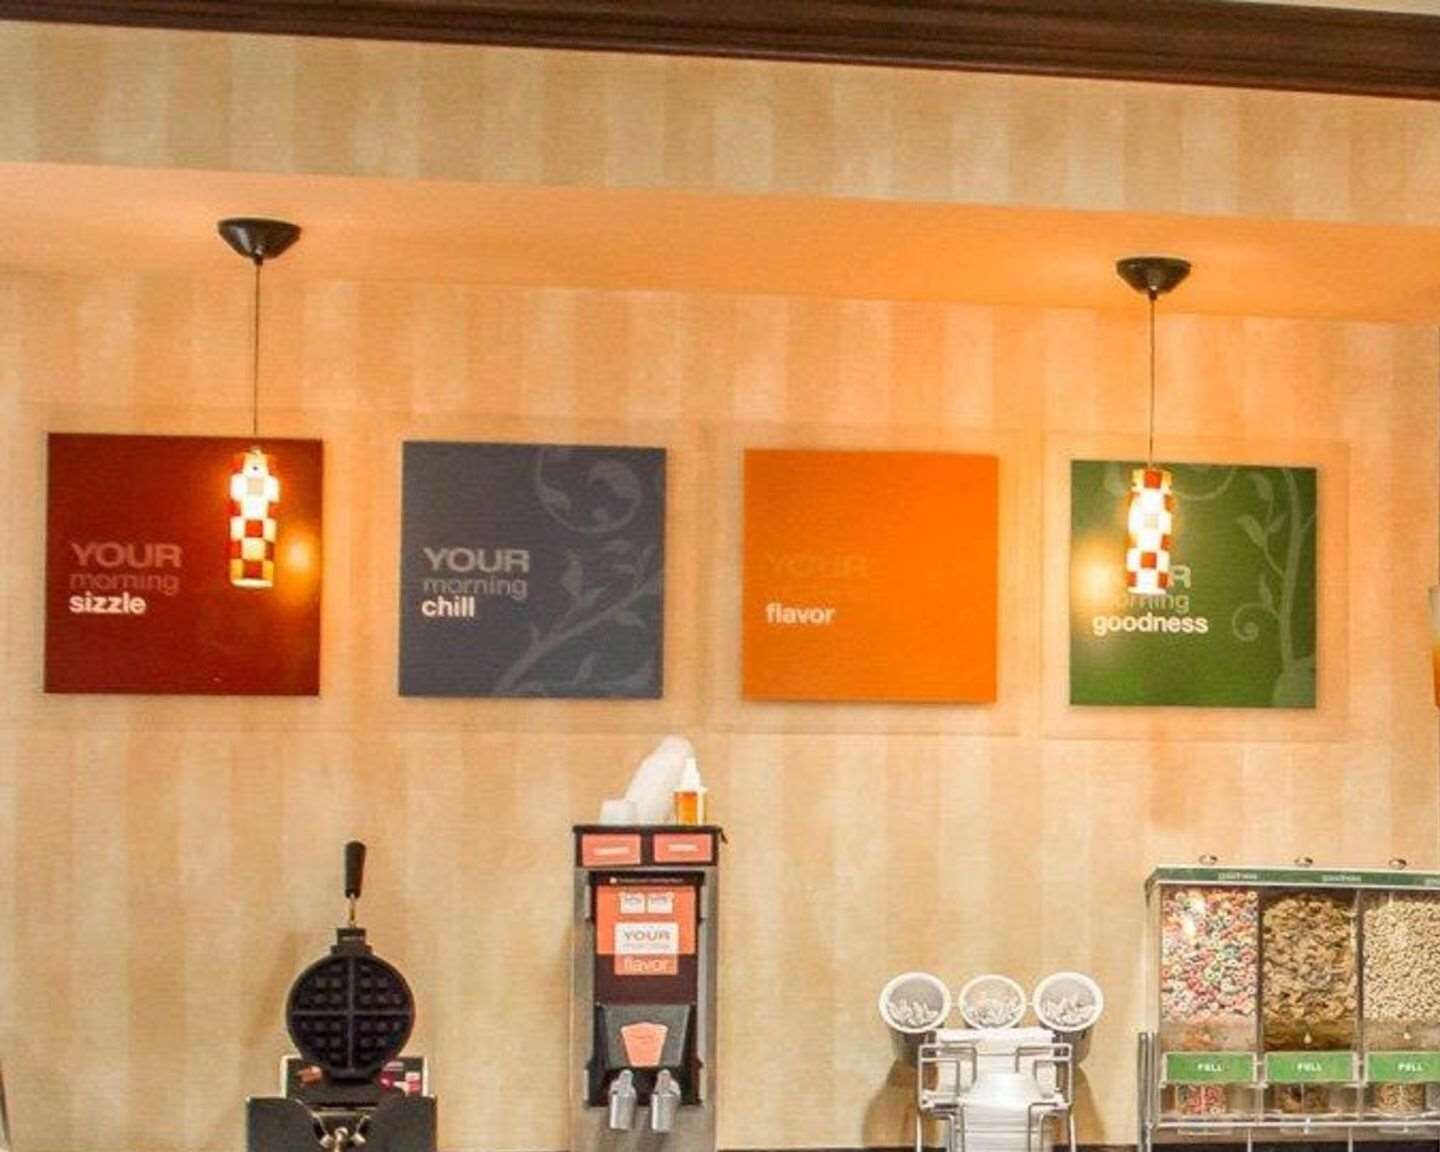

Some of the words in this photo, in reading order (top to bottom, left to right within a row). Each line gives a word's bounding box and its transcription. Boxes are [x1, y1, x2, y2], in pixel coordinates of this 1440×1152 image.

[71, 542, 182, 568] YOUR
[423, 548, 530, 573] YOUR
[69, 573, 180, 596] morning
[423, 575, 528, 601] morning
[69, 590, 147, 614] sizzle
[421, 595, 476, 617] chill
[765, 601, 836, 624] flavor
[1092, 611, 1209, 636] goodness
[623, 929, 671, 941] YOUR
